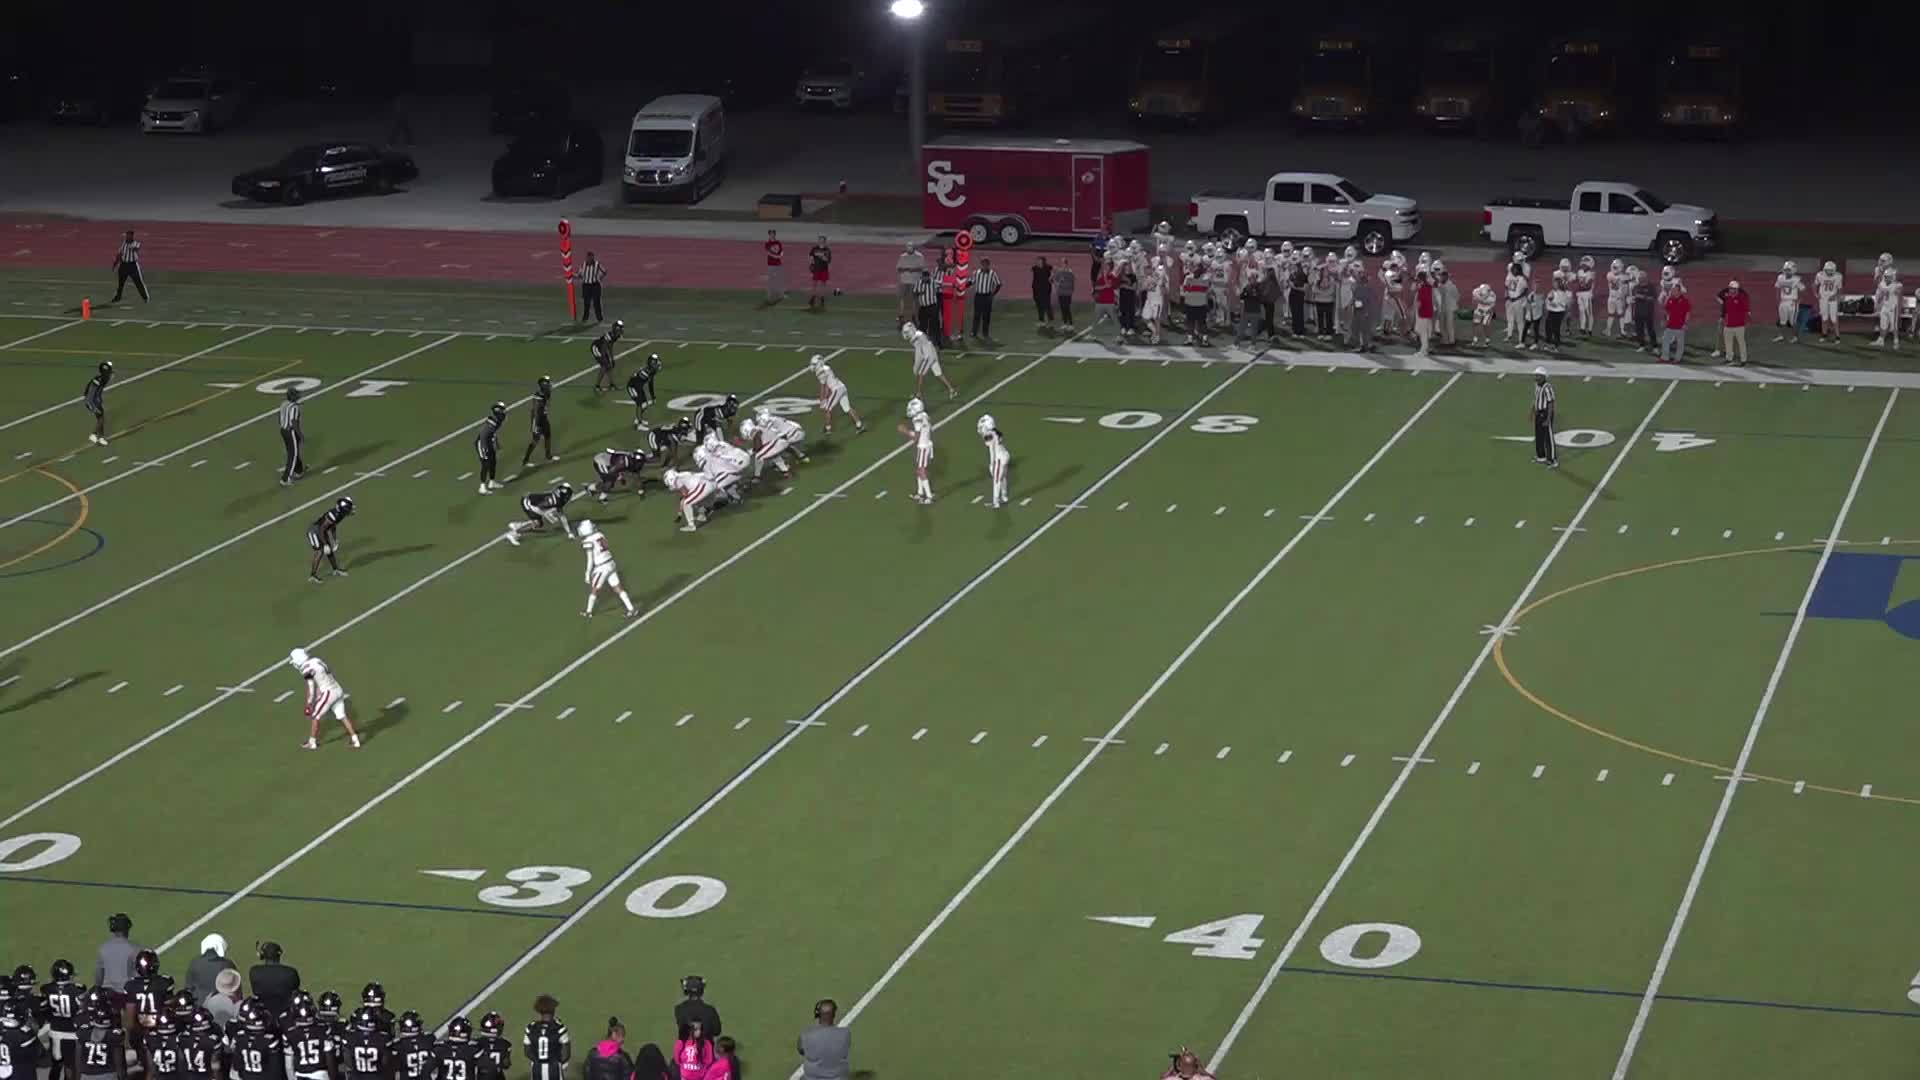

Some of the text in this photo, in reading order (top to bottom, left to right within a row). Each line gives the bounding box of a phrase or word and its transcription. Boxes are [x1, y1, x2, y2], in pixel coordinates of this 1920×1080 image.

[49, 994, 72, 1018] 50
[136, 992, 158, 1013] 71
[85, 1041, 107, 1066] 75
[297, 1039, 320, 1065] 15
[354, 1047, 379, 1072] 62
[538, 1036, 550, 1059] 0
[153, 1049, 177, 1073] 42
[184, 1048, 206, 1072] 14
[241, 1049, 263, 1073] 18
[443, 1059, 467, 1080] 73
